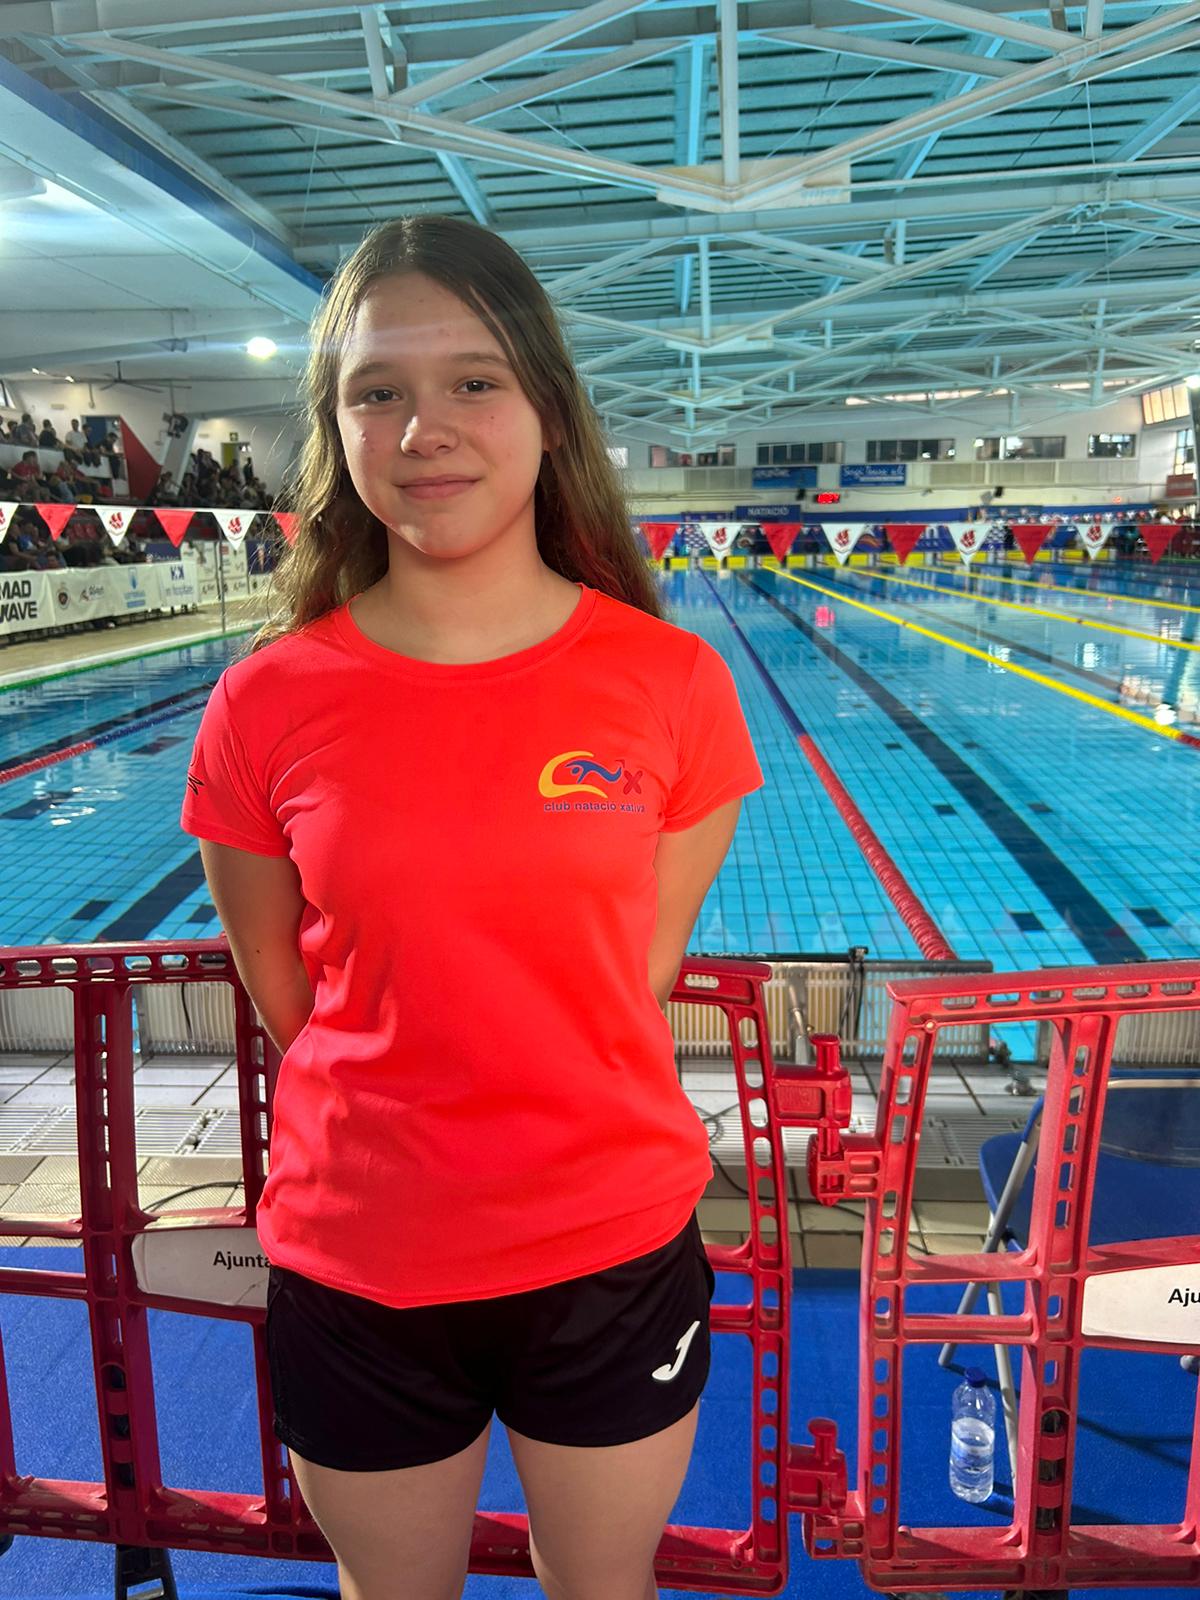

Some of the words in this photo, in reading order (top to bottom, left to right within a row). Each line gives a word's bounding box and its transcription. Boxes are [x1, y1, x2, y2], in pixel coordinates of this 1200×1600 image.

[0, 580, 31, 599] MAD
[543, 802, 571, 812] club
[575, 801, 617, 811] natacio
